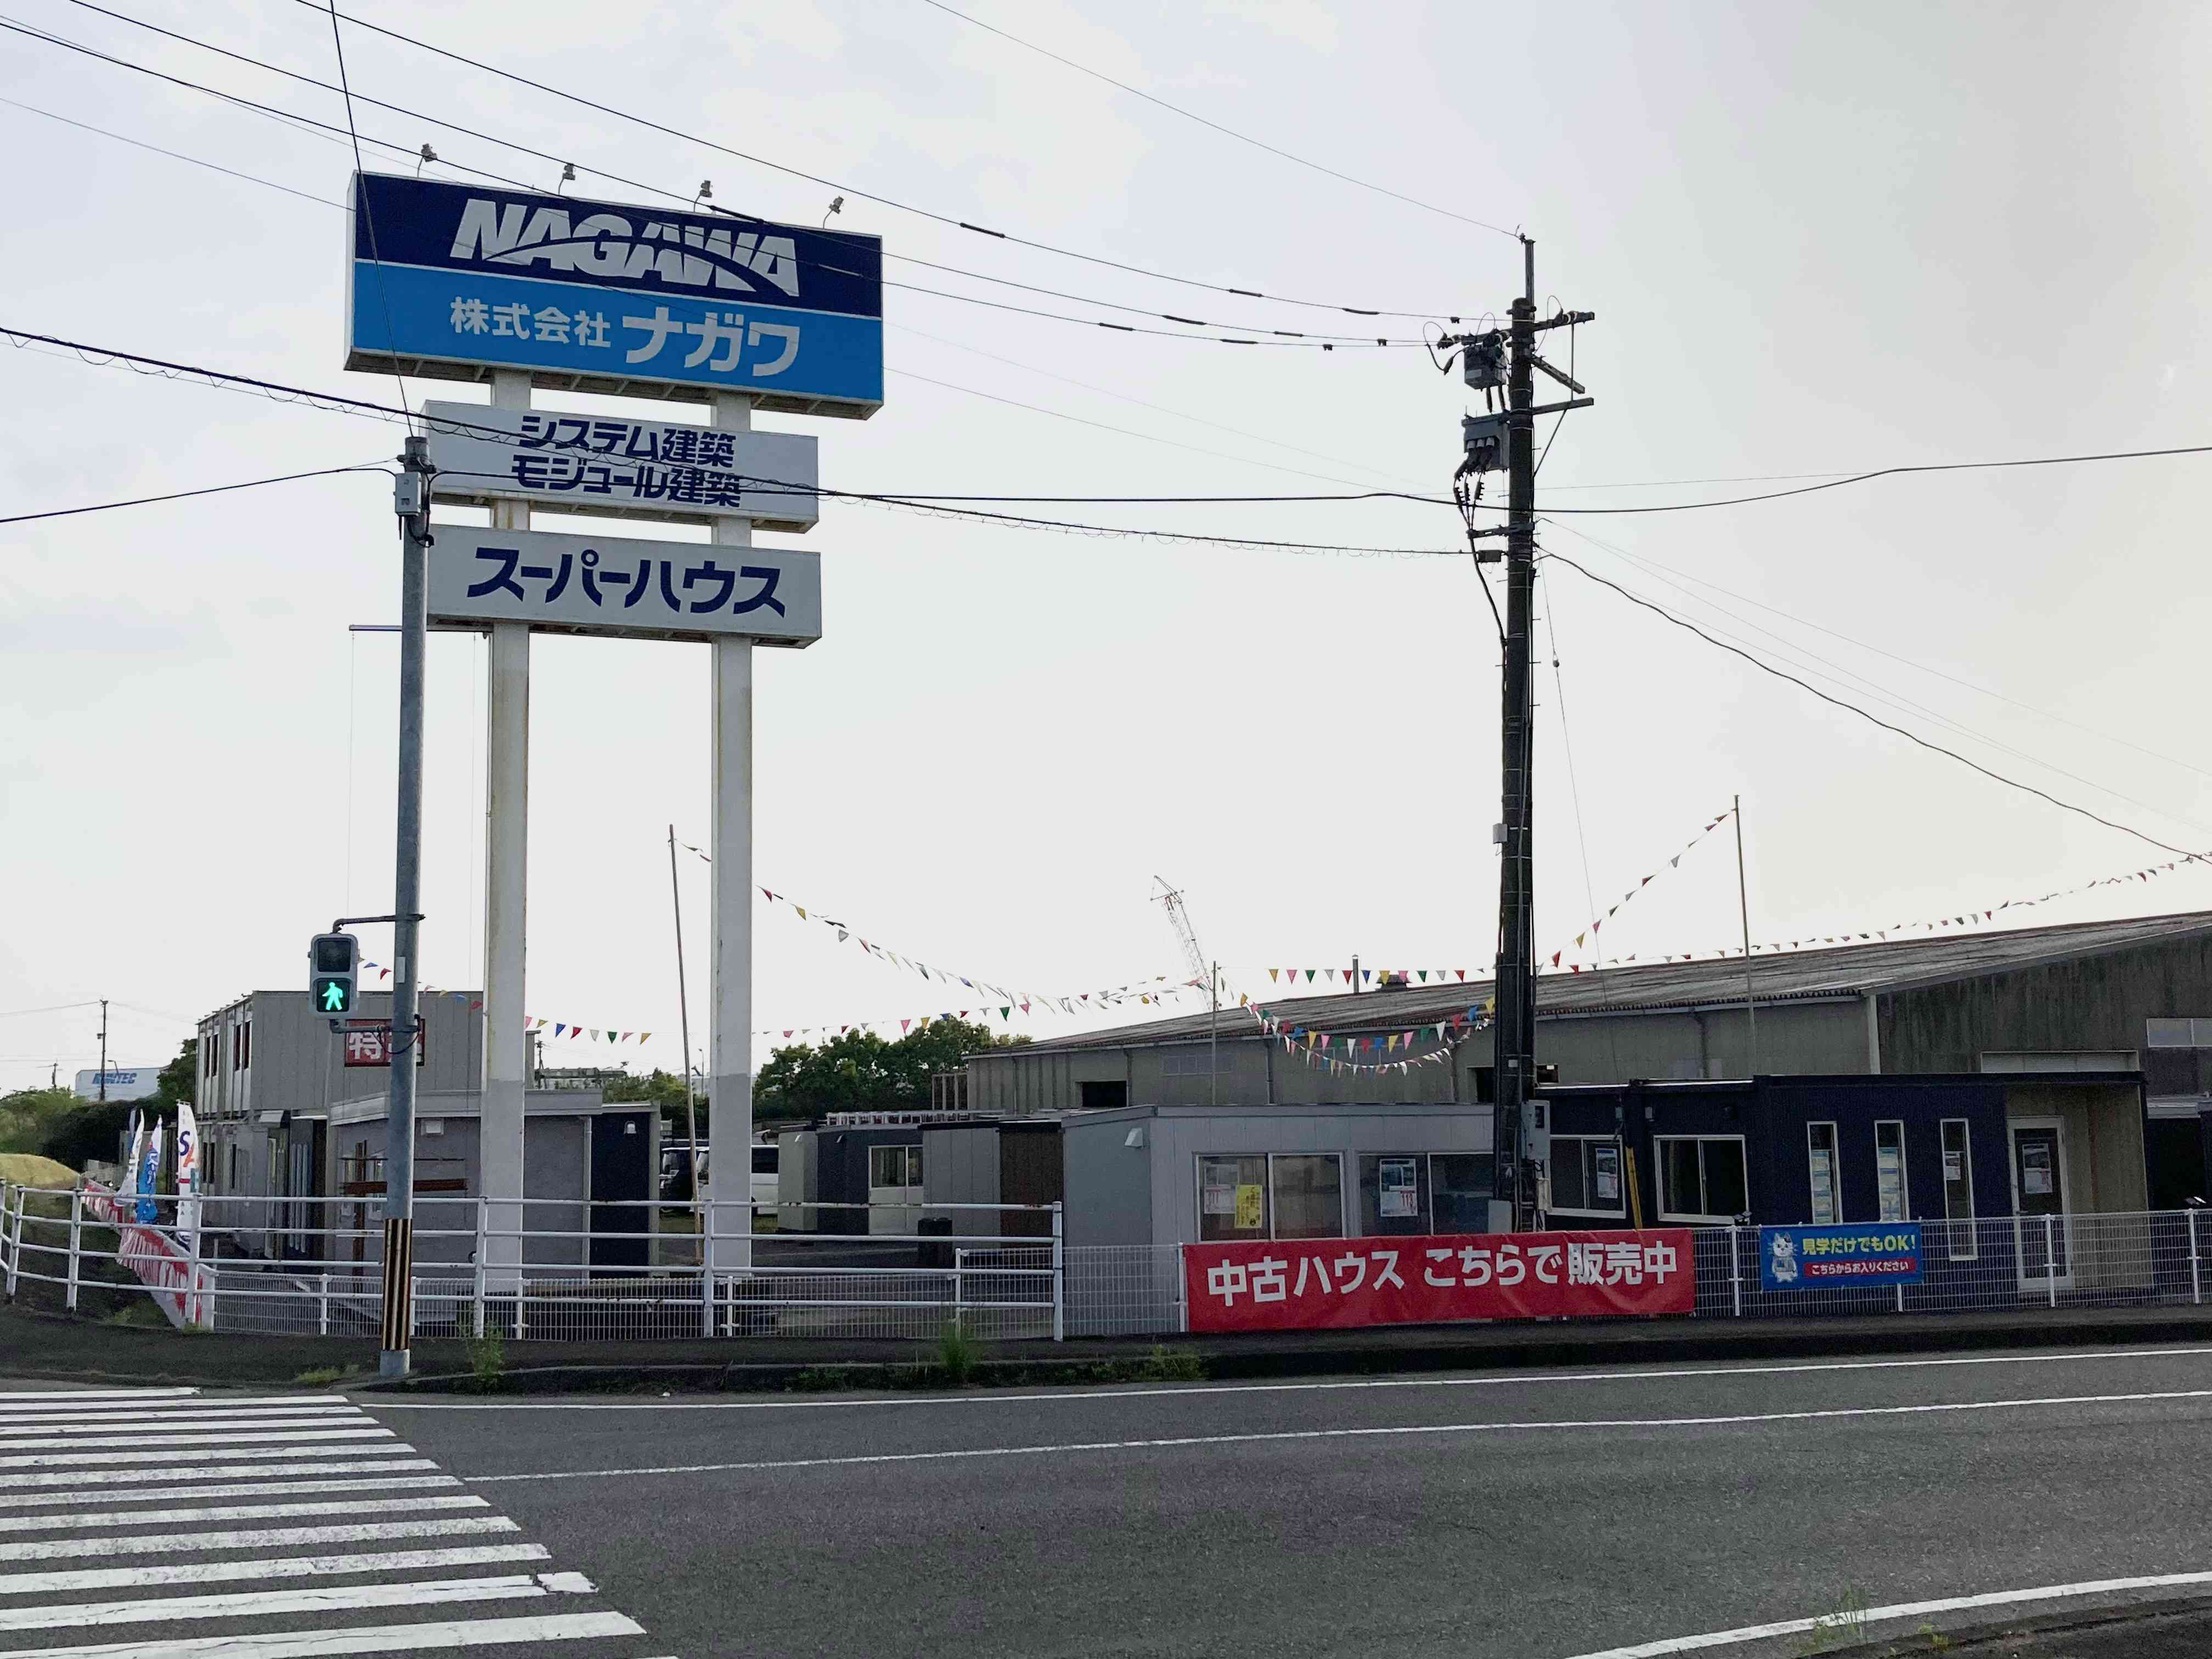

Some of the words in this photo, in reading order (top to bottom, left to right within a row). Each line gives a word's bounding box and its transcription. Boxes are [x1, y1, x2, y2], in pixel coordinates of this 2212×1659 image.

[450, 198, 799, 297] NAGAWA
[518, 415, 736, 469] システム建築
[511, 453, 743, 507] モジュール建築
[466, 546, 786, 618] スーパーハウス
[1207, 1251, 1405, 1307] 中古ハウス
[1424, 1240, 1677, 1287] こちらで販売中
